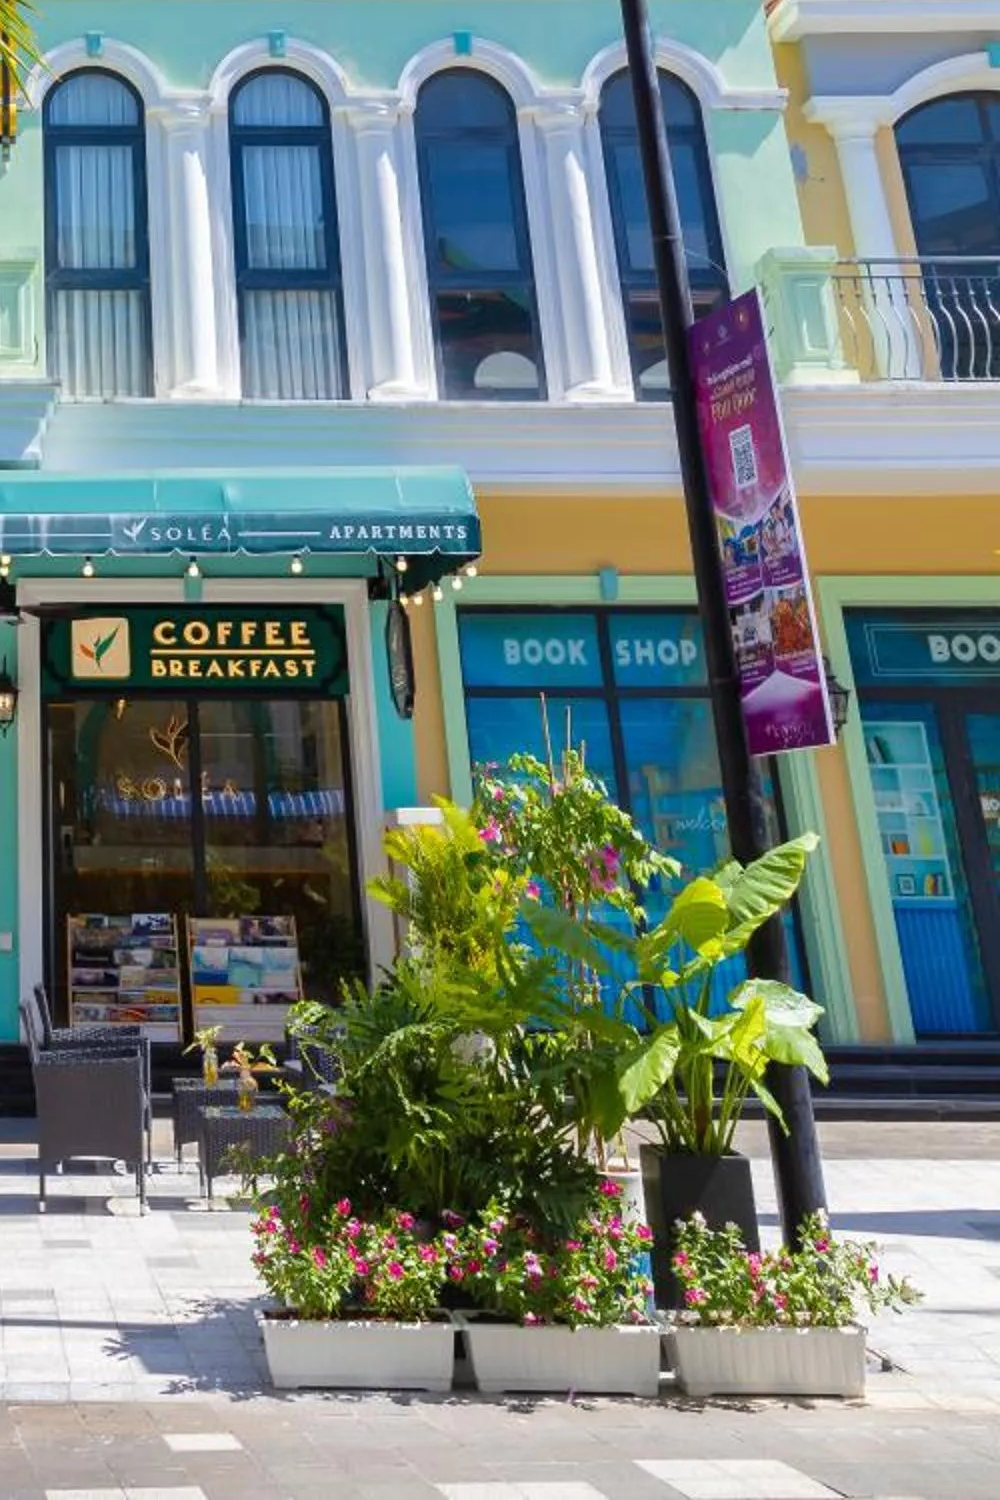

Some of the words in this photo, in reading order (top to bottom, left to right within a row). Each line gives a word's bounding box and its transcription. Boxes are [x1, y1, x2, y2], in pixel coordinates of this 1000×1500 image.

[151, 523, 231, 542] SOLÉA
[329, 525, 468, 540] APARTMENTS
[152, 621, 312, 646] COFFEE
[503, 638, 589, 667] BOOK
[615, 638, 699, 668] SHOP
[150, 658, 317, 678] BREAKFAST
